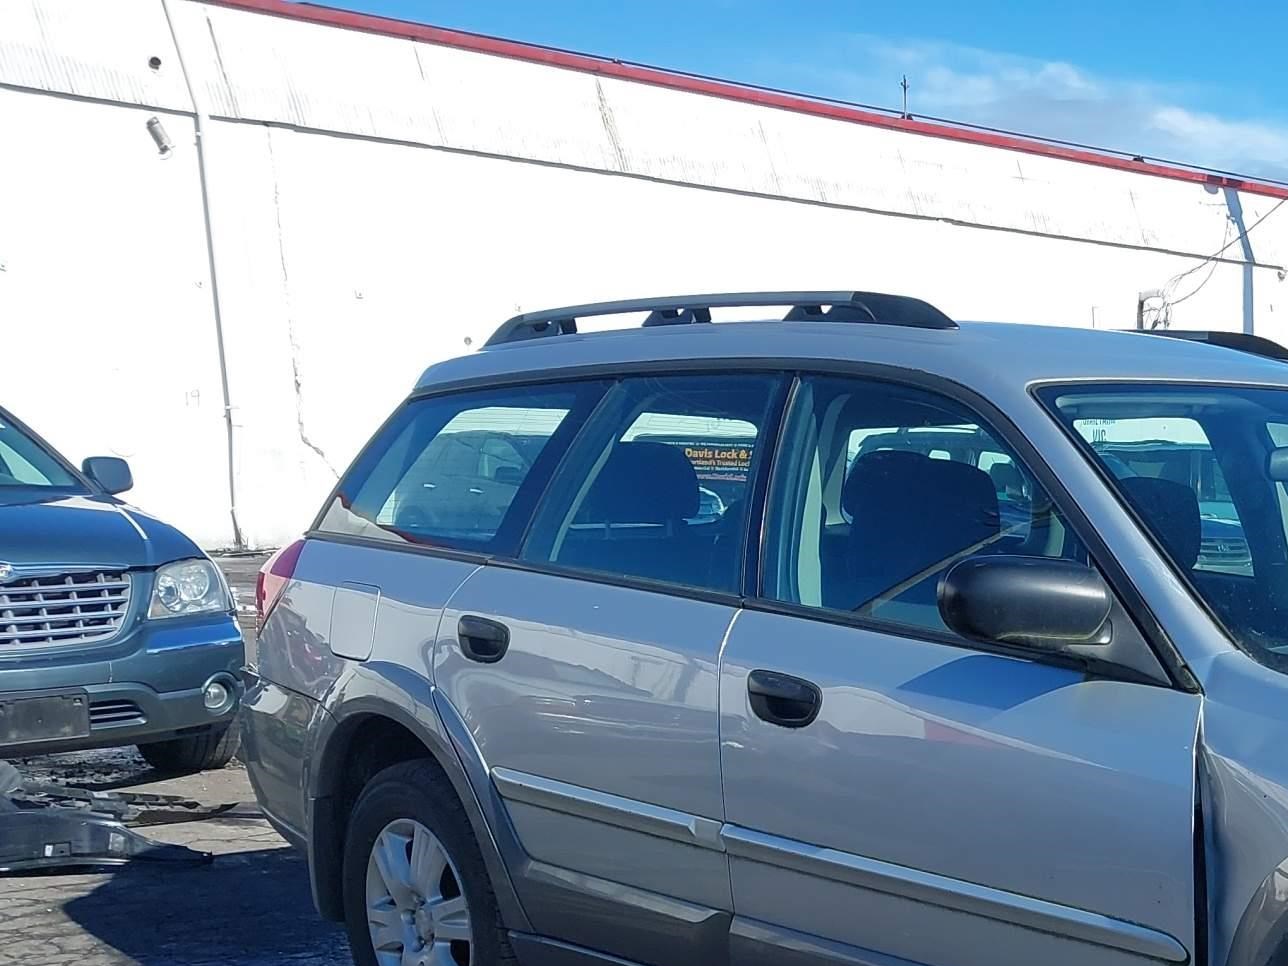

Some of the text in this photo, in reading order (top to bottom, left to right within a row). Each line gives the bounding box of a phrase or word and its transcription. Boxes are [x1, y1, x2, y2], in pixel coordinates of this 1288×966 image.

[685, 447, 713, 458] Davis
[715, 448, 738, 459] Lock
[739, 449, 747, 459] &
